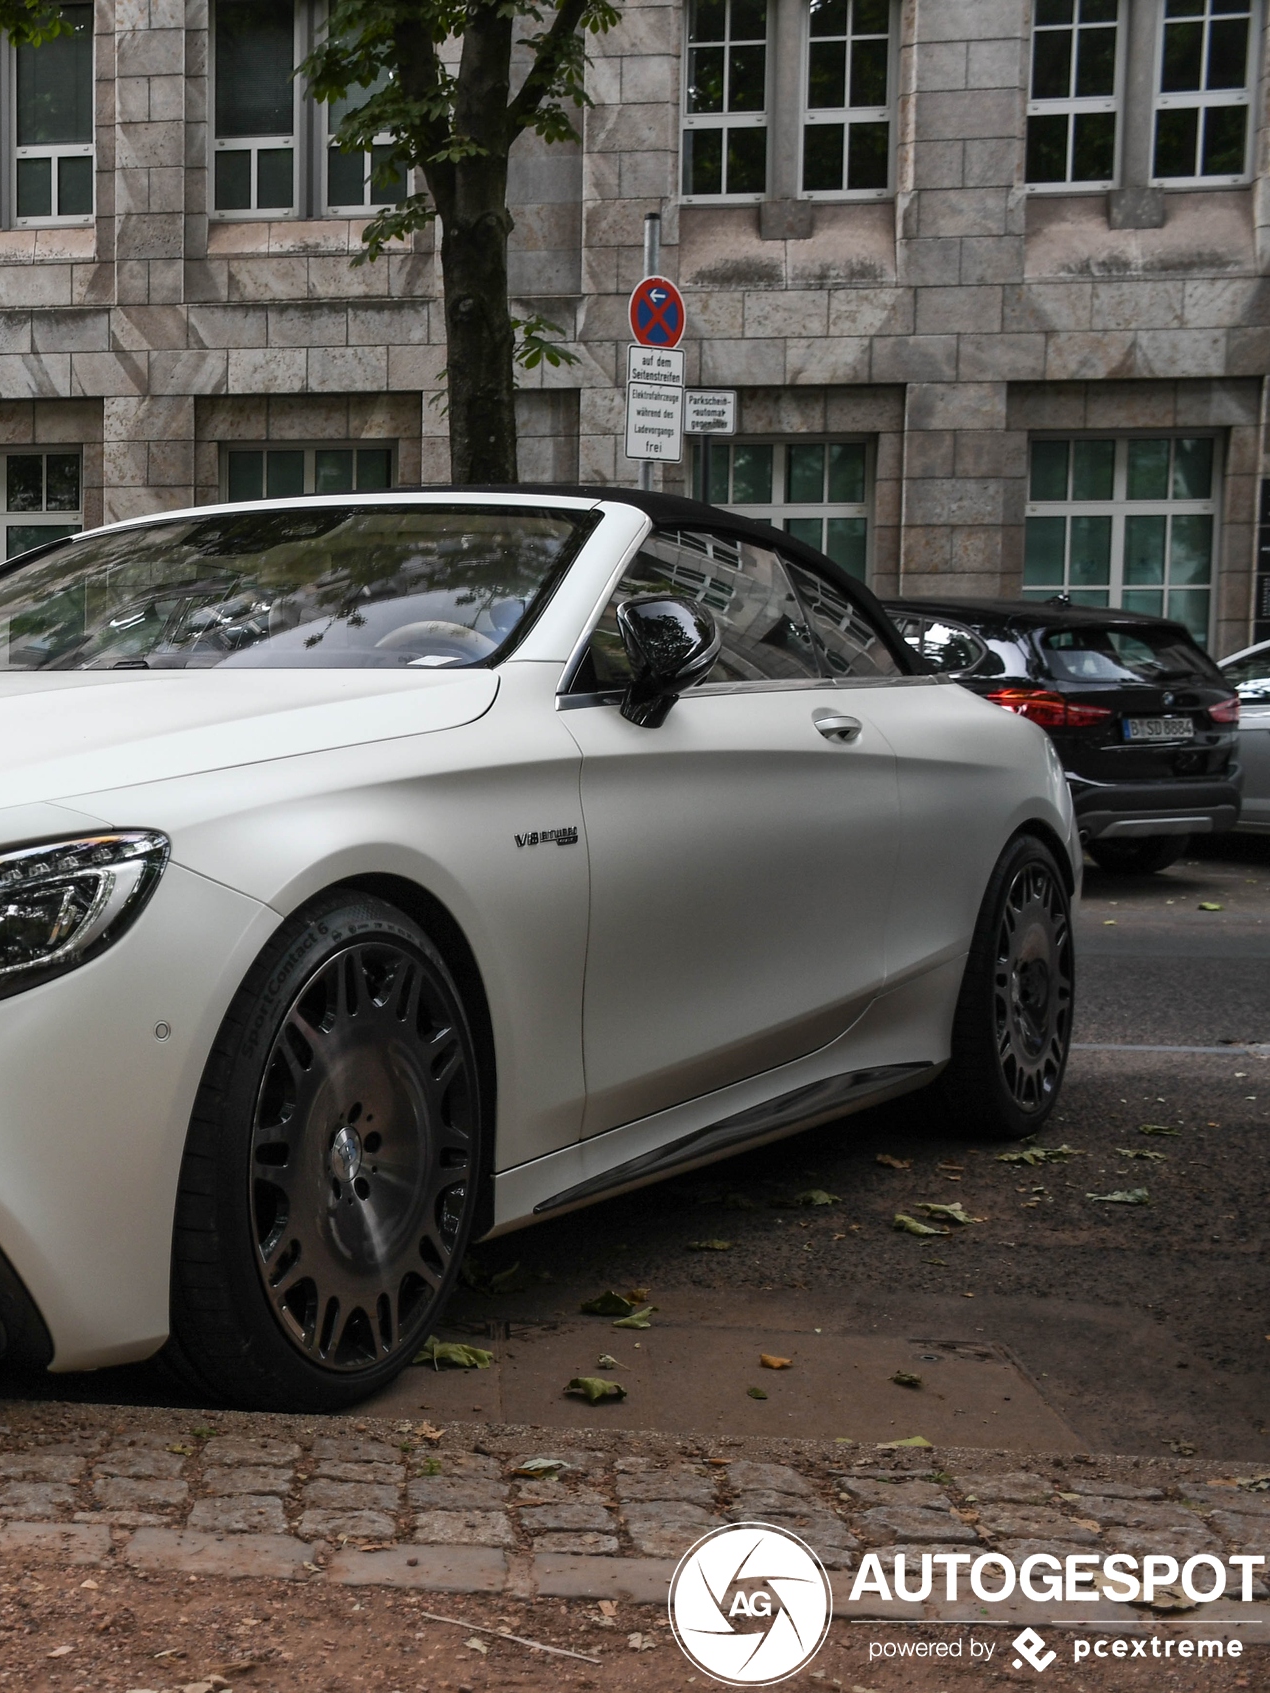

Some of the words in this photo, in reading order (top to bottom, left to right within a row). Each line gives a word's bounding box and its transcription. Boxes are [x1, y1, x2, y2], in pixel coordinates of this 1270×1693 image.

[642, 355, 654, 366] auf
[657, 356, 671, 368] dem
[632, 368, 680, 383] Seitenstreifen
[632, 389, 679, 404] Elektrofahrzeuge
[689, 395, 731, 406] Parkschein-
[636, 407, 661, 418] während
[663, 409, 674, 419] des
[634, 423, 674, 438] Ladevorgangs
[645, 441, 662, 453] frei
[1130, 721, 1139, 736] B
[1146, 720, 1162, 736] SD
[1164, 720, 1193, 735] 8884
[514, 832, 539, 848] V8
[240, 931, 319, 1060] SportContact
[317, 921, 330, 936] 6
